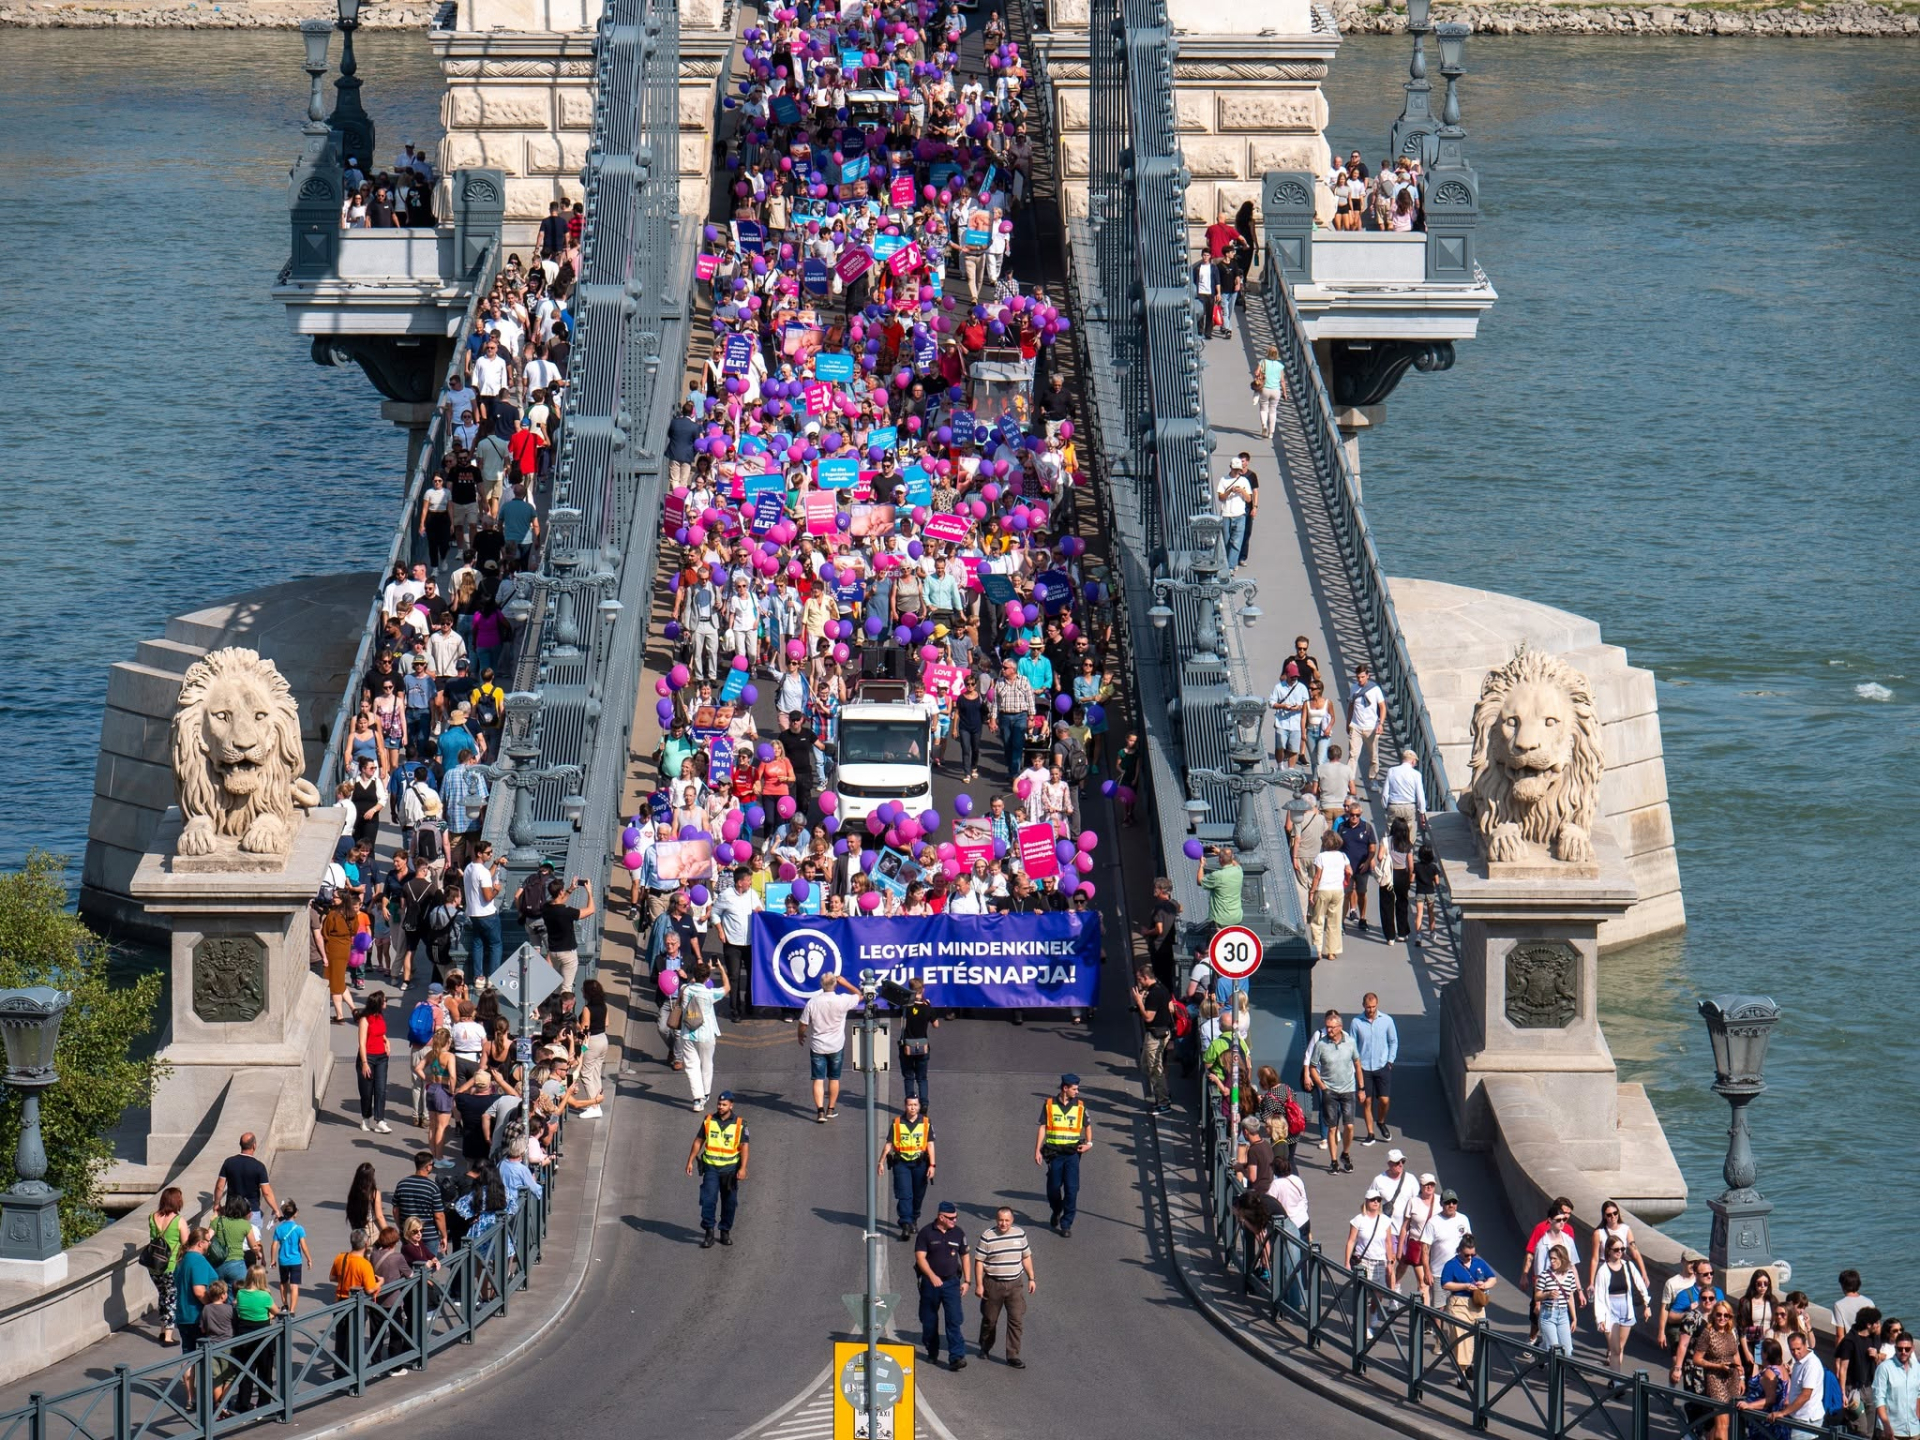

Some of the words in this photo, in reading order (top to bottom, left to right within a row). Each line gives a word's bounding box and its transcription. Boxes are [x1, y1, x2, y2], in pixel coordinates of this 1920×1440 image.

[894, 252, 906, 262] LOVE
[726, 358, 748, 368] ÉLET.
[810, 388, 822, 396] LOVE
[954, 419, 971, 427] Every
[1003, 422, 1015, 431] Every
[927, 523, 966, 536] AJÁNDÉK
[934, 669, 953, 677] LOVE
[714, 750, 730, 759] Every
[712, 759, 721, 767] life
[652, 803, 667, 812] Every
[1023, 838, 1051, 849] Nincsenek
[1023, 844, 1053, 855] potenciális
[860, 942, 932, 960] LEGYEN
[938, 941, 1076, 956] MINDENKINEK
[1223, 941, 1249, 963] 30
